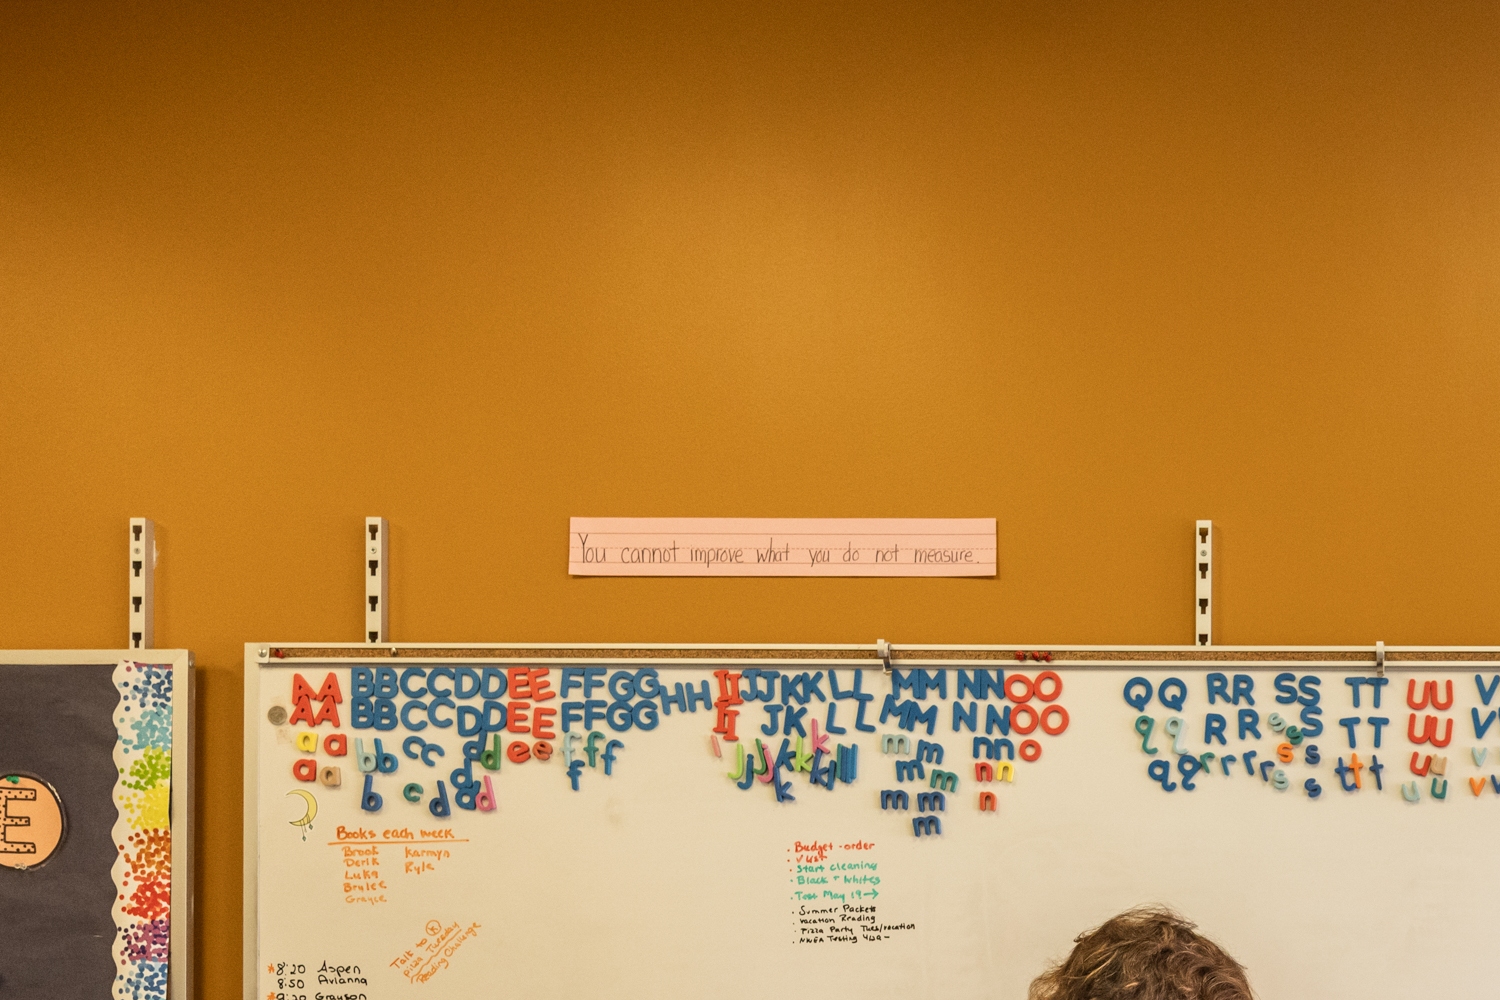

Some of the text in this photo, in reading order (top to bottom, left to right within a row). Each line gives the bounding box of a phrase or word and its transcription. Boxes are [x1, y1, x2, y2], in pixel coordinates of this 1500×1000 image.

[578, 533, 981, 568] You cannot improve what you do not measure.
[336, 826, 455, 840] Books each week
[794, 841, 833, 857] Budget
[389, 950, 414, 969] Talk
[276, 960, 361, 977] 8:20 Aspen
[277, 977, 305, 989] 8:50
